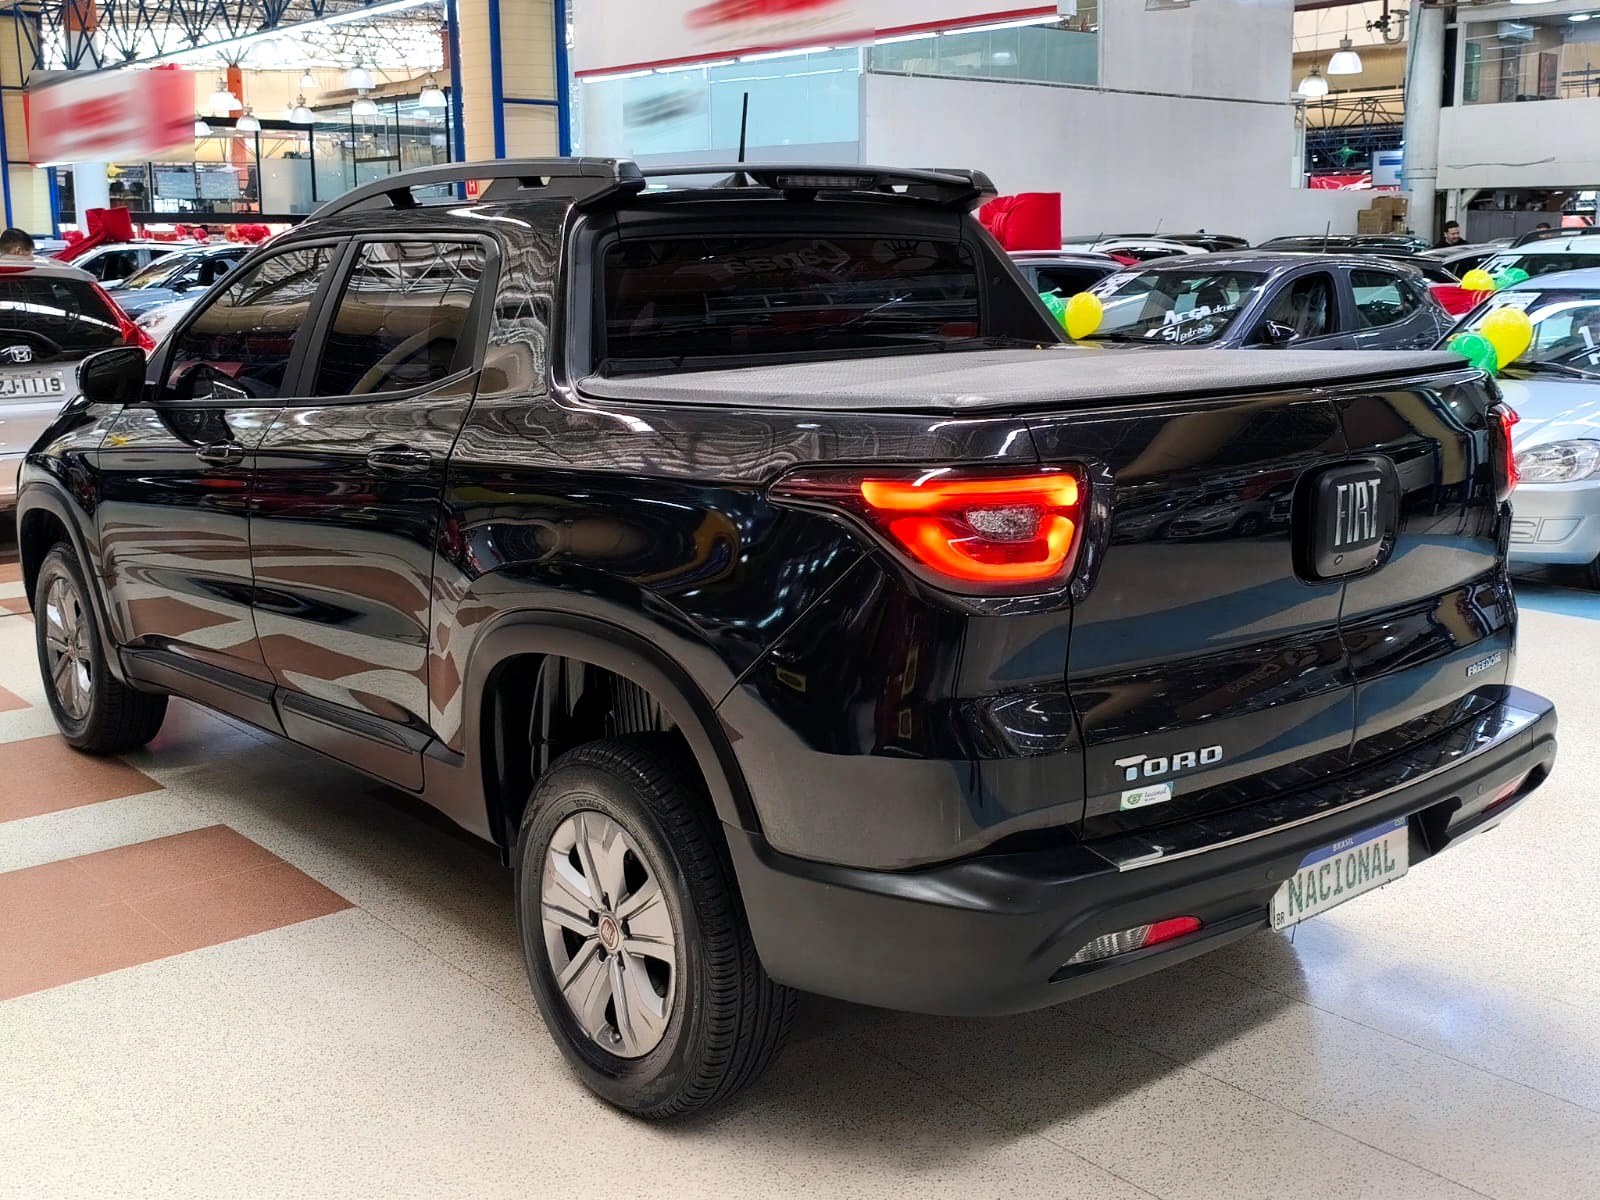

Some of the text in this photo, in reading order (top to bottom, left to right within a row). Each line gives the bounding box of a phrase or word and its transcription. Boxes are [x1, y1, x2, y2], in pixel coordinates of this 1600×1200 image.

[1335, 479, 1381, 546] FIAT
[1466, 651, 1502, 677] FREEDOM
[1114, 745, 1223, 781] TORO
[1332, 838, 1354, 852] BRASIL
[1288, 840, 1396, 916] NACIONAL
[1276, 911, 1285, 926] BR
